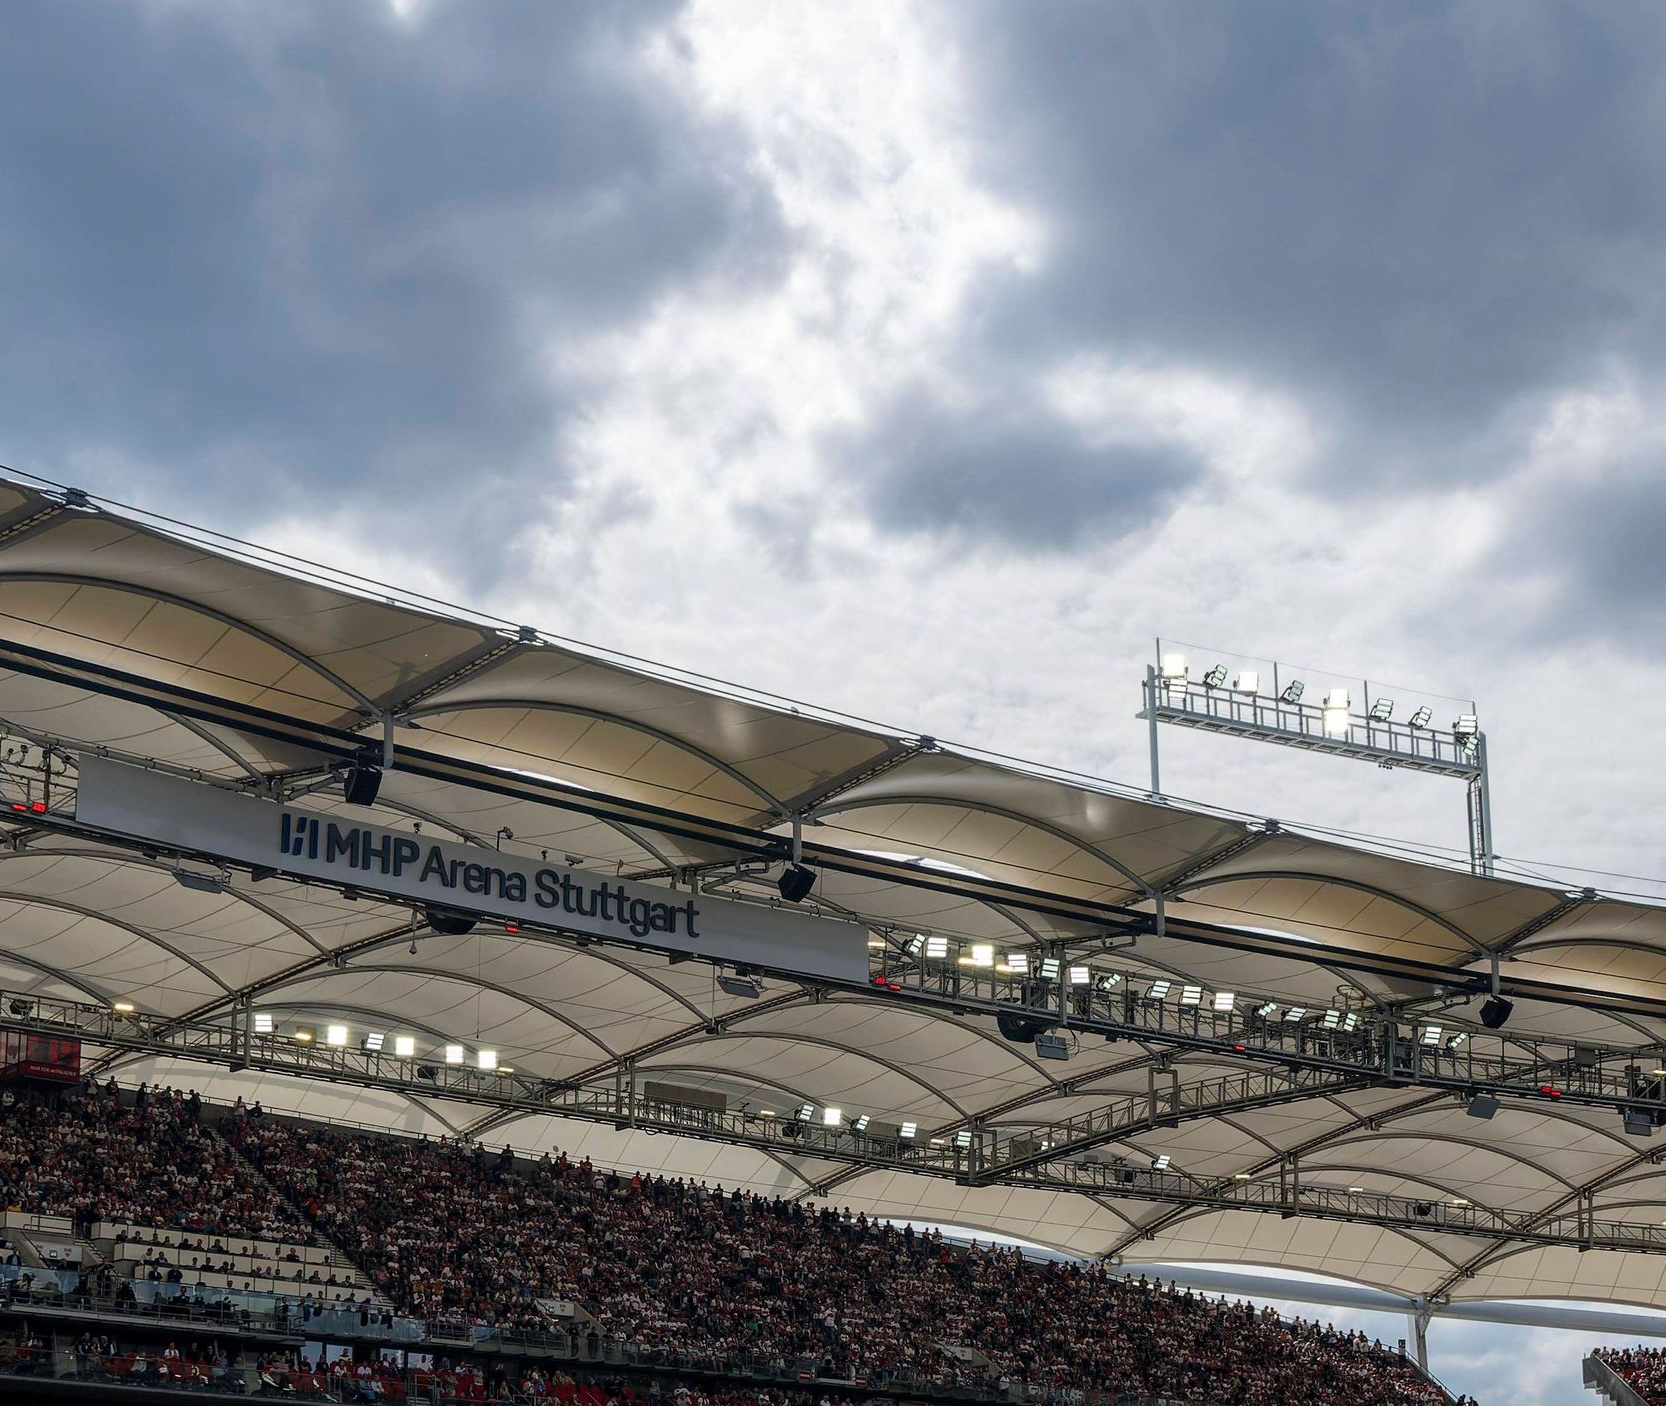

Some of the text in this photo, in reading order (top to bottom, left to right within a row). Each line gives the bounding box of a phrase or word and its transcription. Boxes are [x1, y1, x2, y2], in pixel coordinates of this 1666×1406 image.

[327, 823, 700, 938] MHP Arena Stuttgart
